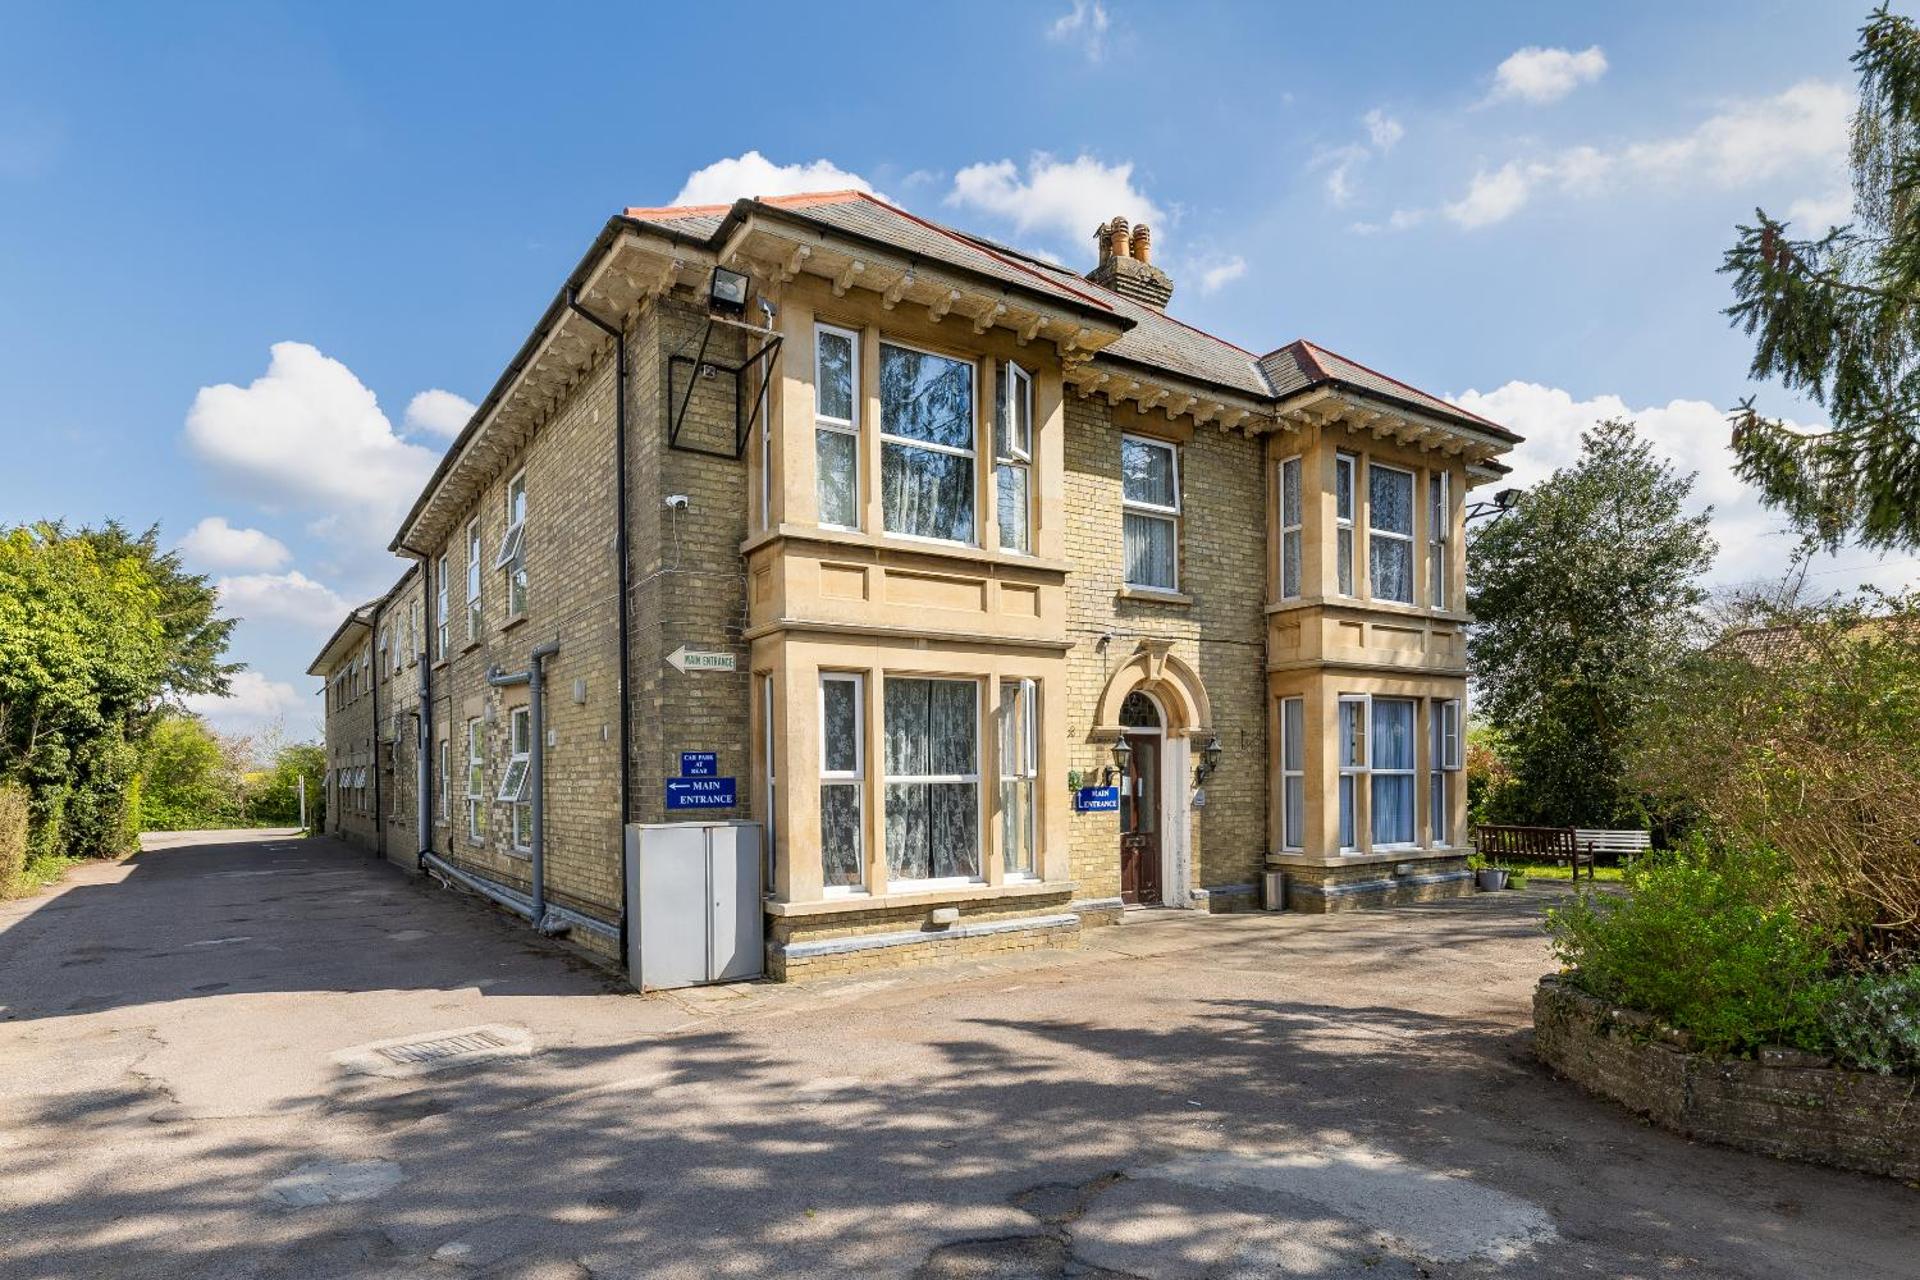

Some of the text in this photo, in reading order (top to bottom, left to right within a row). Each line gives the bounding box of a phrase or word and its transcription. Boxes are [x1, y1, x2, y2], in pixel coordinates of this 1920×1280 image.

[684, 655, 734, 668] MAIN ENTRANCE
[693, 781, 720, 790] MAIN
[680, 795, 733, 804] ENTRANCE
